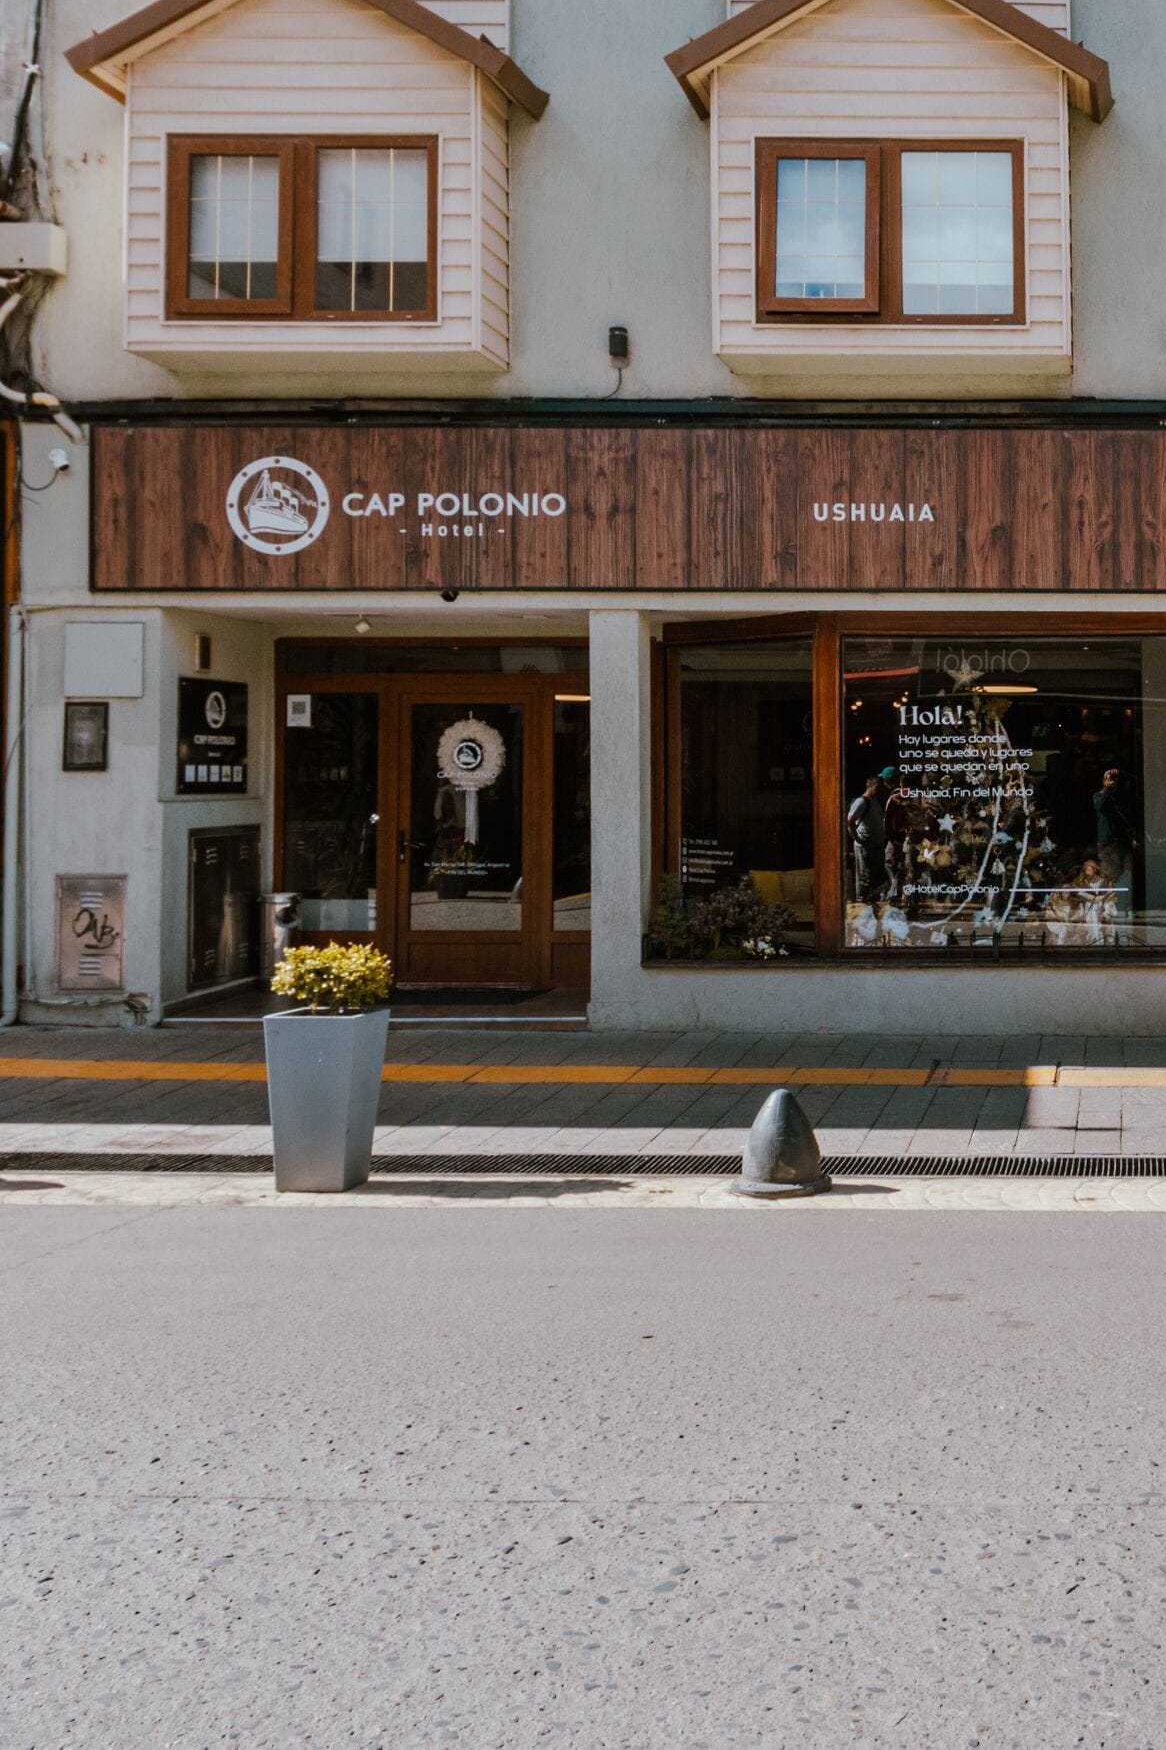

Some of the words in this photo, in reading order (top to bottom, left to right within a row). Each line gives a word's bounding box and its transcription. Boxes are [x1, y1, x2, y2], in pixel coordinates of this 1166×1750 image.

[341, 492, 405, 517] CAP
[417, 492, 567, 517] POLONIO
[813, 503, 935, 522] USHUAIA
[421, 523, 483, 537] Hotel
[899, 705, 964, 726] Hola!
[899, 735, 920, 746] Hay
[922, 735, 966, 746] lugares
[968, 735, 1006, 744] donde
[899, 750, 922, 758] uno
[925, 750, 939, 758] se
[941, 749, 979, 759] queda
[981, 750, 988, 759] y
[989, 749, 1033, 759] lugares
[899, 764, 922, 774] que
[924, 764, 938, 772] se
[940, 762, 986, 774] quedan
[988, 763, 1003, 771] en
[1005, 763, 1030, 771] uno
[900, 788, 951, 798] Ushuaia,
[953, 788, 971, 797] Fin
[972, 788, 990, 797] del
[992, 788, 1034, 797] Mundo
[903, 884, 1000, 896] @HotelCapPolonio
